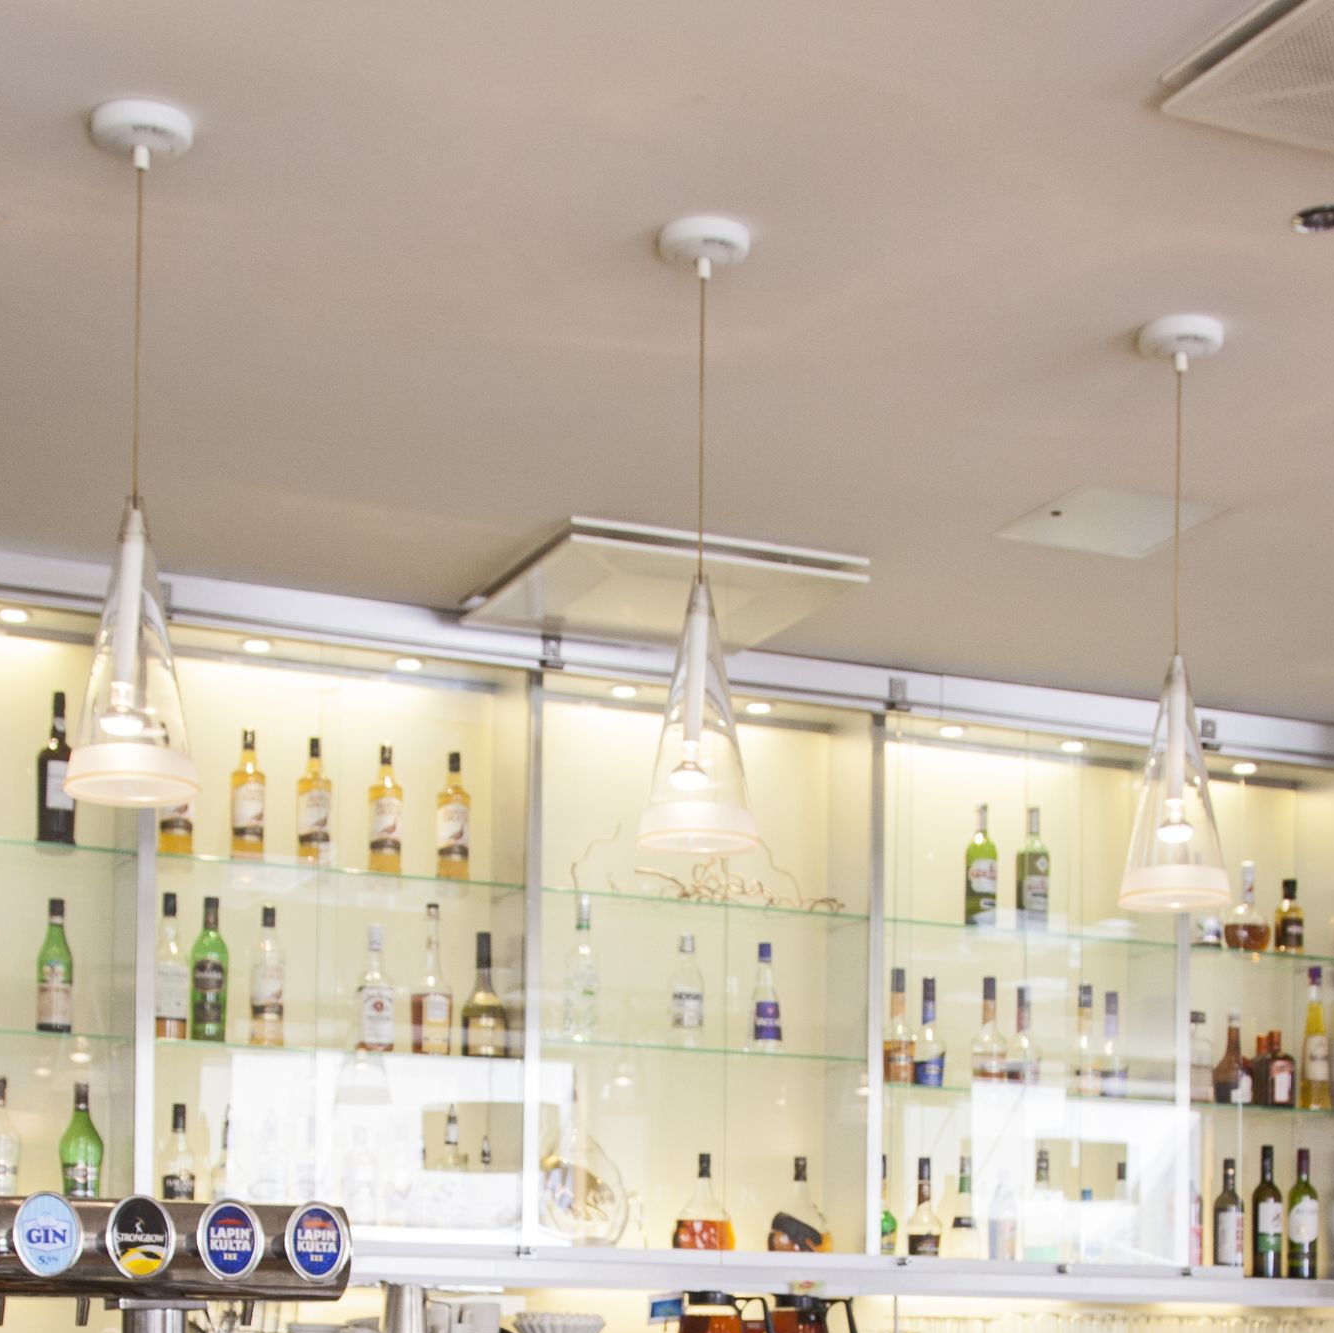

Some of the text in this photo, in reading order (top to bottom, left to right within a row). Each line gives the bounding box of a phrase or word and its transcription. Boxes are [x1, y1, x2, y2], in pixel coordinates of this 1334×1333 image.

[26, 1228, 67, 1244] GIN
[117, 1231, 165, 1243] STRONGBOW
[209, 1227, 252, 1240] LAPIN
[296, 1229, 338, 1242] LAPIN
[210, 1240, 252, 1252] KULTA
[296, 1241, 338, 1253] KULTA
